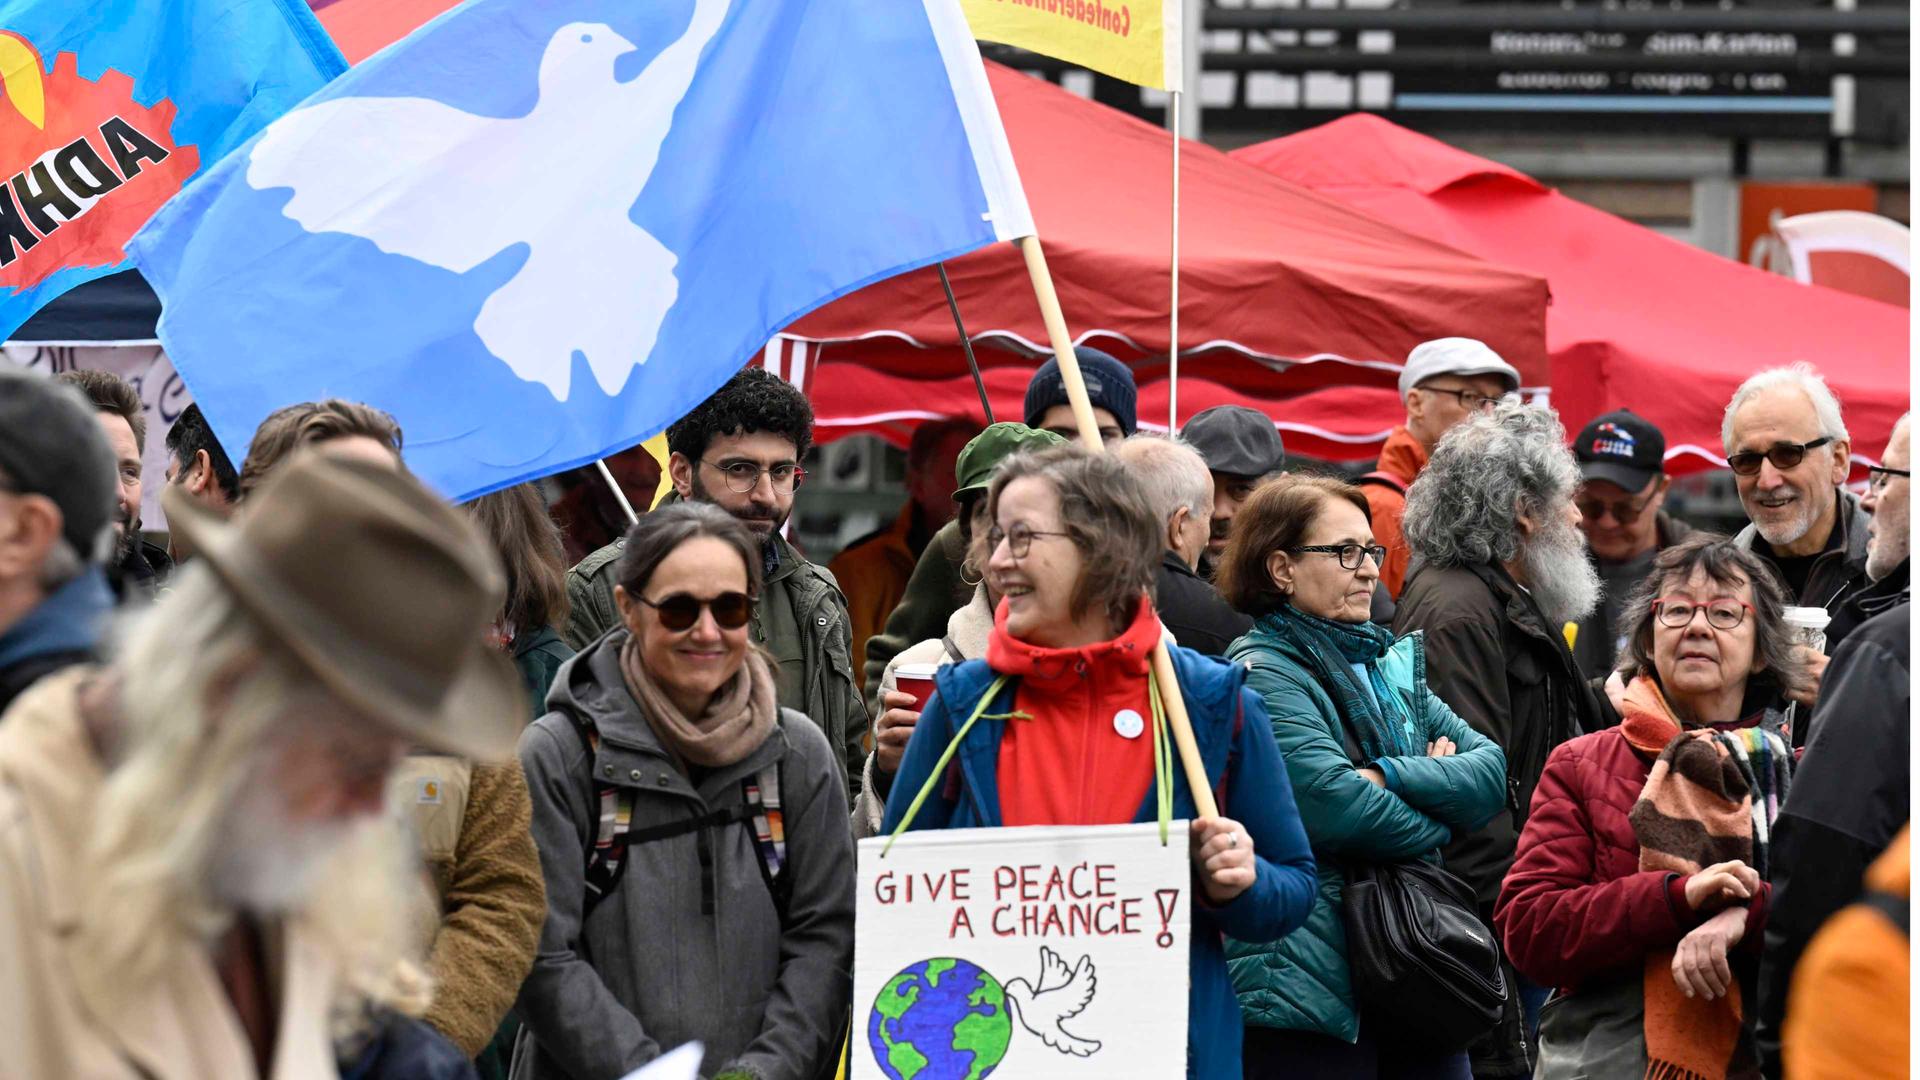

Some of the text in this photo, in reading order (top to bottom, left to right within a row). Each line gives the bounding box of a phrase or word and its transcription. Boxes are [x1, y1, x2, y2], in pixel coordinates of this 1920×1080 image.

[875, 862, 1117, 904] GIVE PEACE
[949, 905, 975, 939] A
